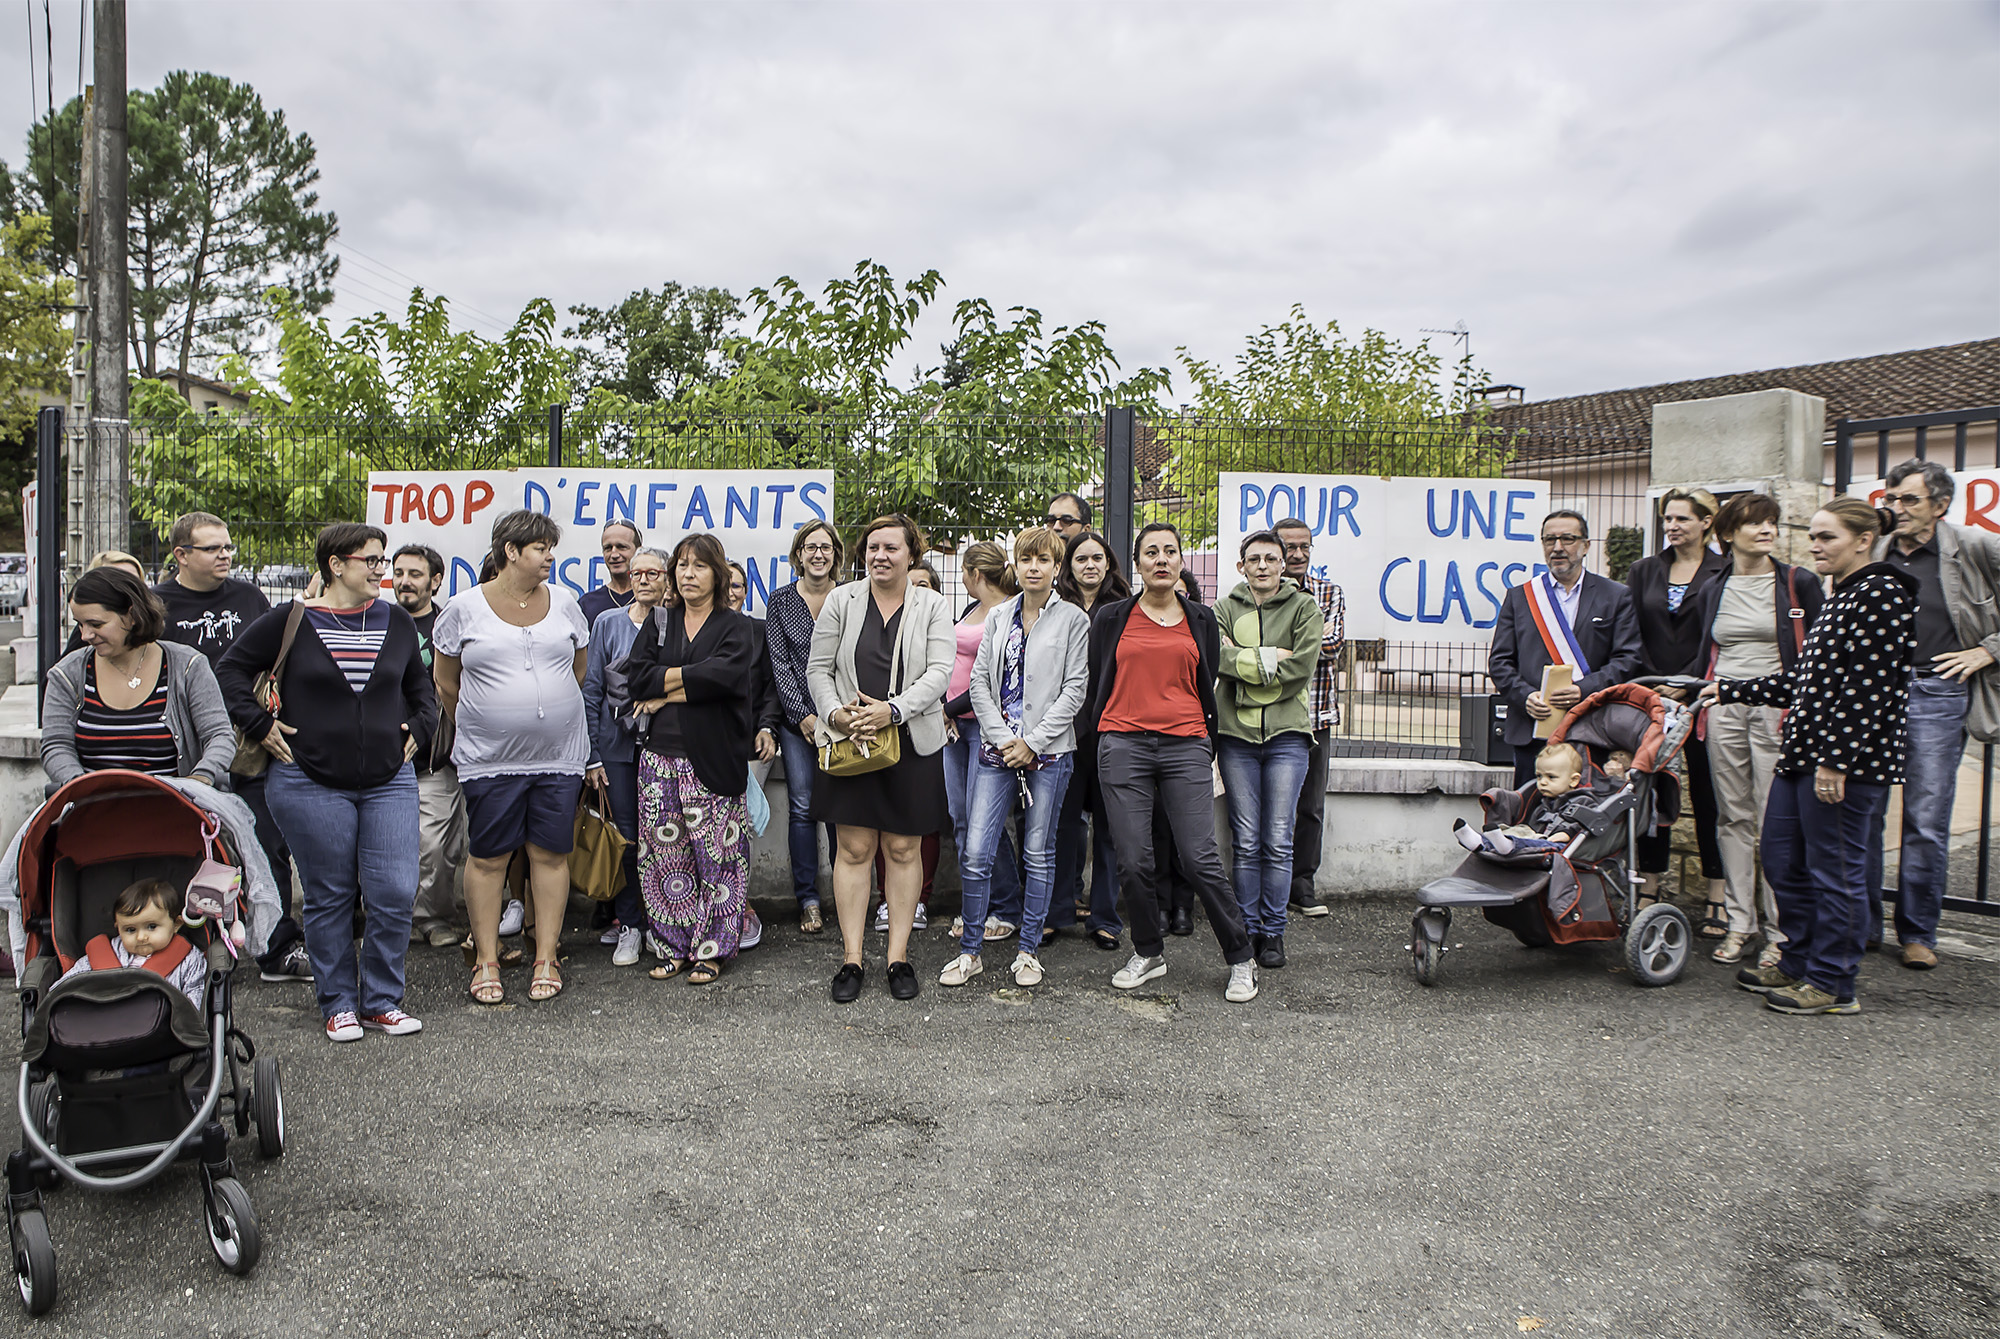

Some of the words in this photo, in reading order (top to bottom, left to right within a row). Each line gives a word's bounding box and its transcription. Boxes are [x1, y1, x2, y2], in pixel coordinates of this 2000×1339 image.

[371, 480, 496, 527] TROP
[524, 477, 828, 531] D'ENFANTS
[1239, 483, 1362, 537] POUR
[1426, 488, 1536, 542] UNE
[1378, 556, 1550, 629] CLAS
